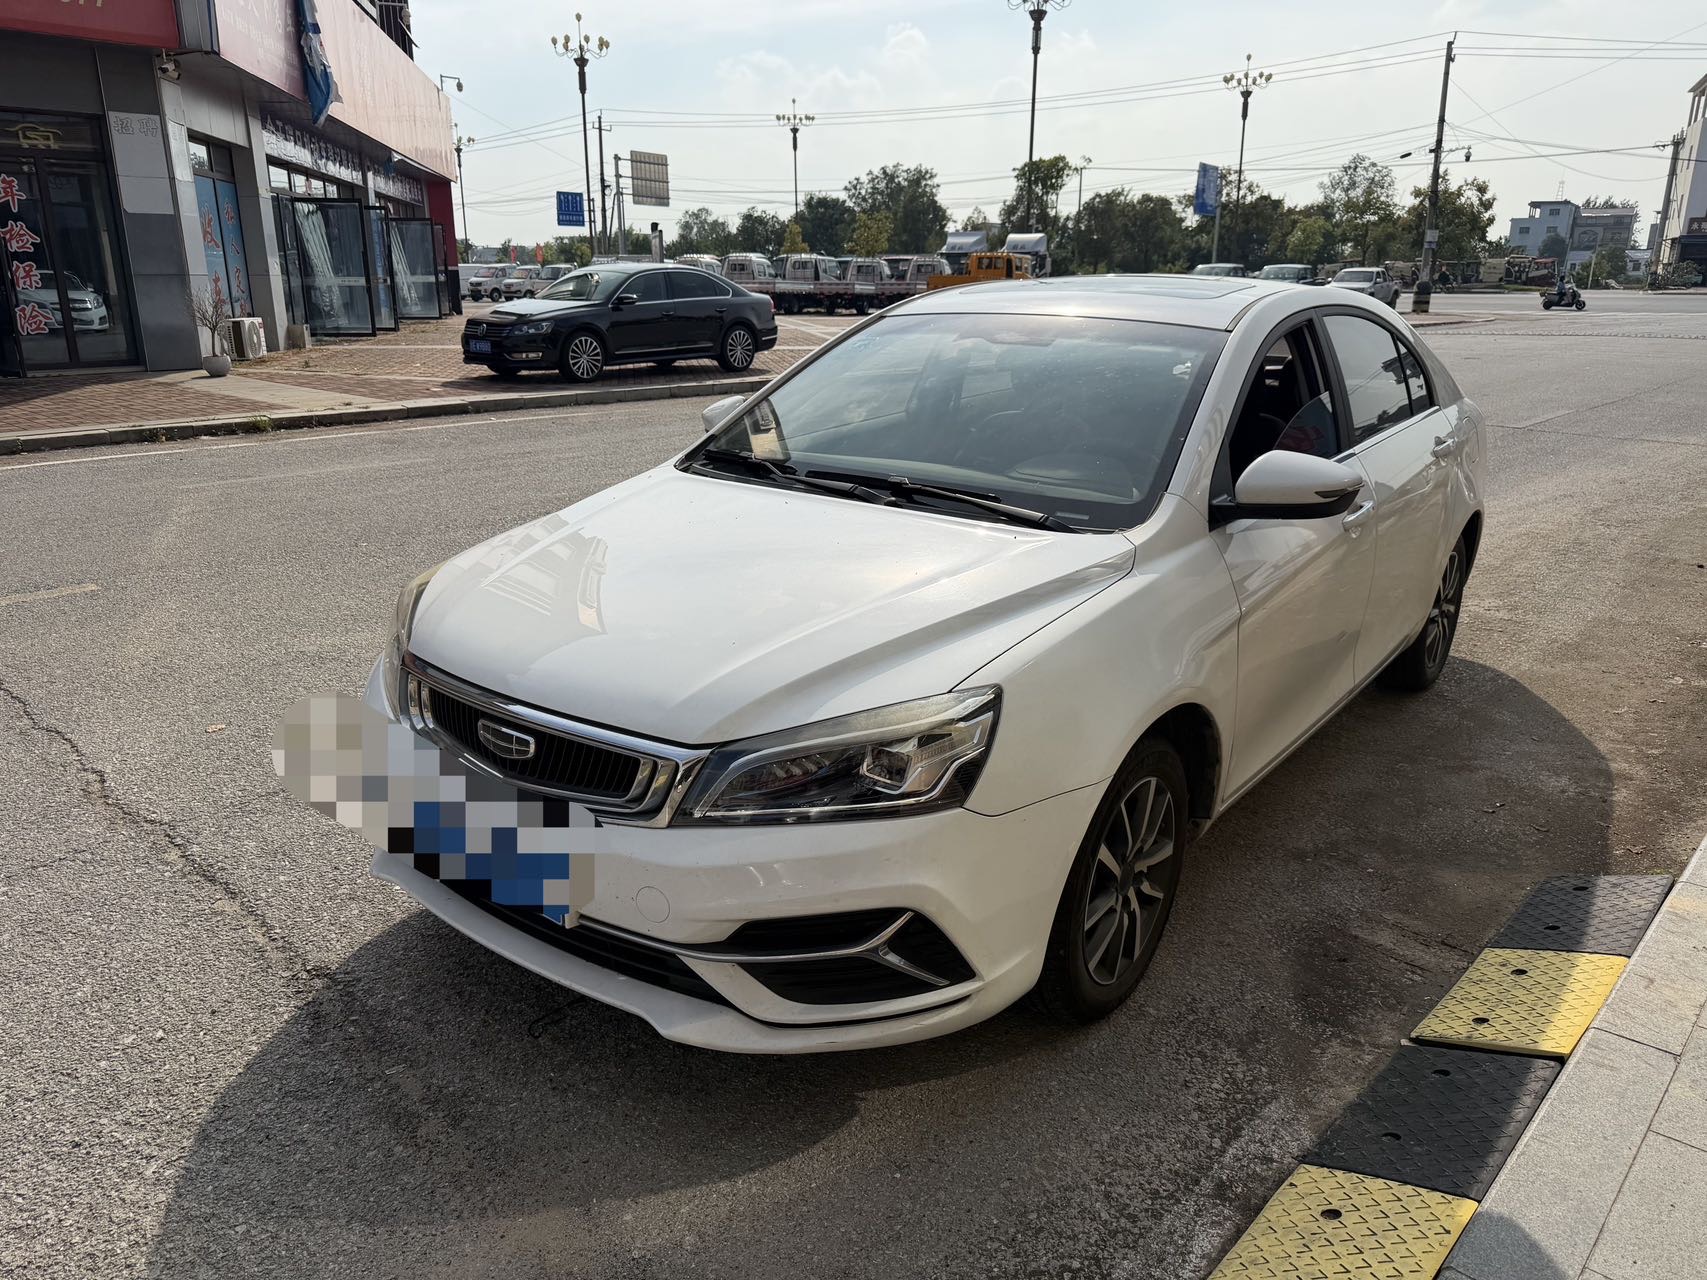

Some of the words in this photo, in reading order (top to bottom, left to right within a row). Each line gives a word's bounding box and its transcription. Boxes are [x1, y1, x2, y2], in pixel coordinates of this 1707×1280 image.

[113, 116, 158, 137] 招聘
[0, 174, 53, 336] 年检保险
